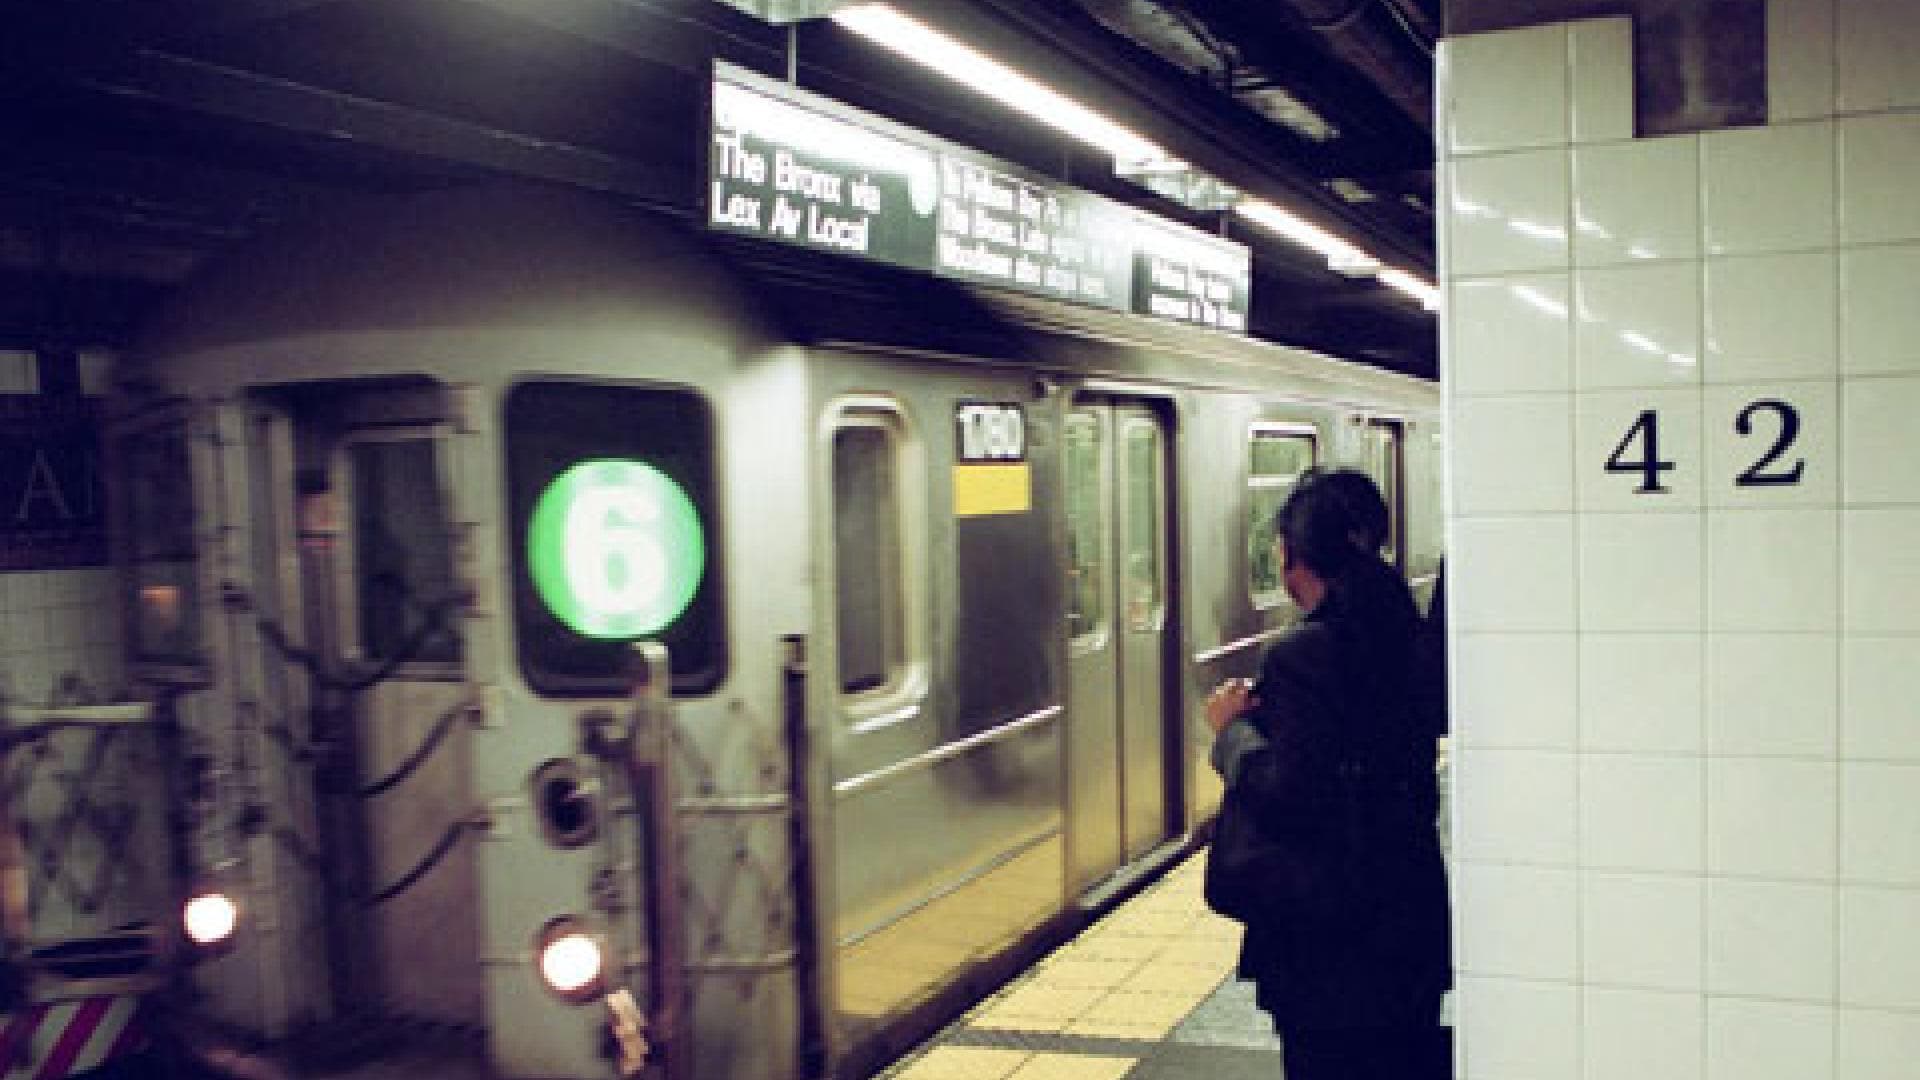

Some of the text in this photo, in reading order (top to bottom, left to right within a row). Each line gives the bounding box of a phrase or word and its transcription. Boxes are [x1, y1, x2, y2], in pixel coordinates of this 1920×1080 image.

[716, 133, 881, 214] The Bronx via
[711, 181, 869, 252] Lex Av Local
[563, 482, 668, 617] 6
